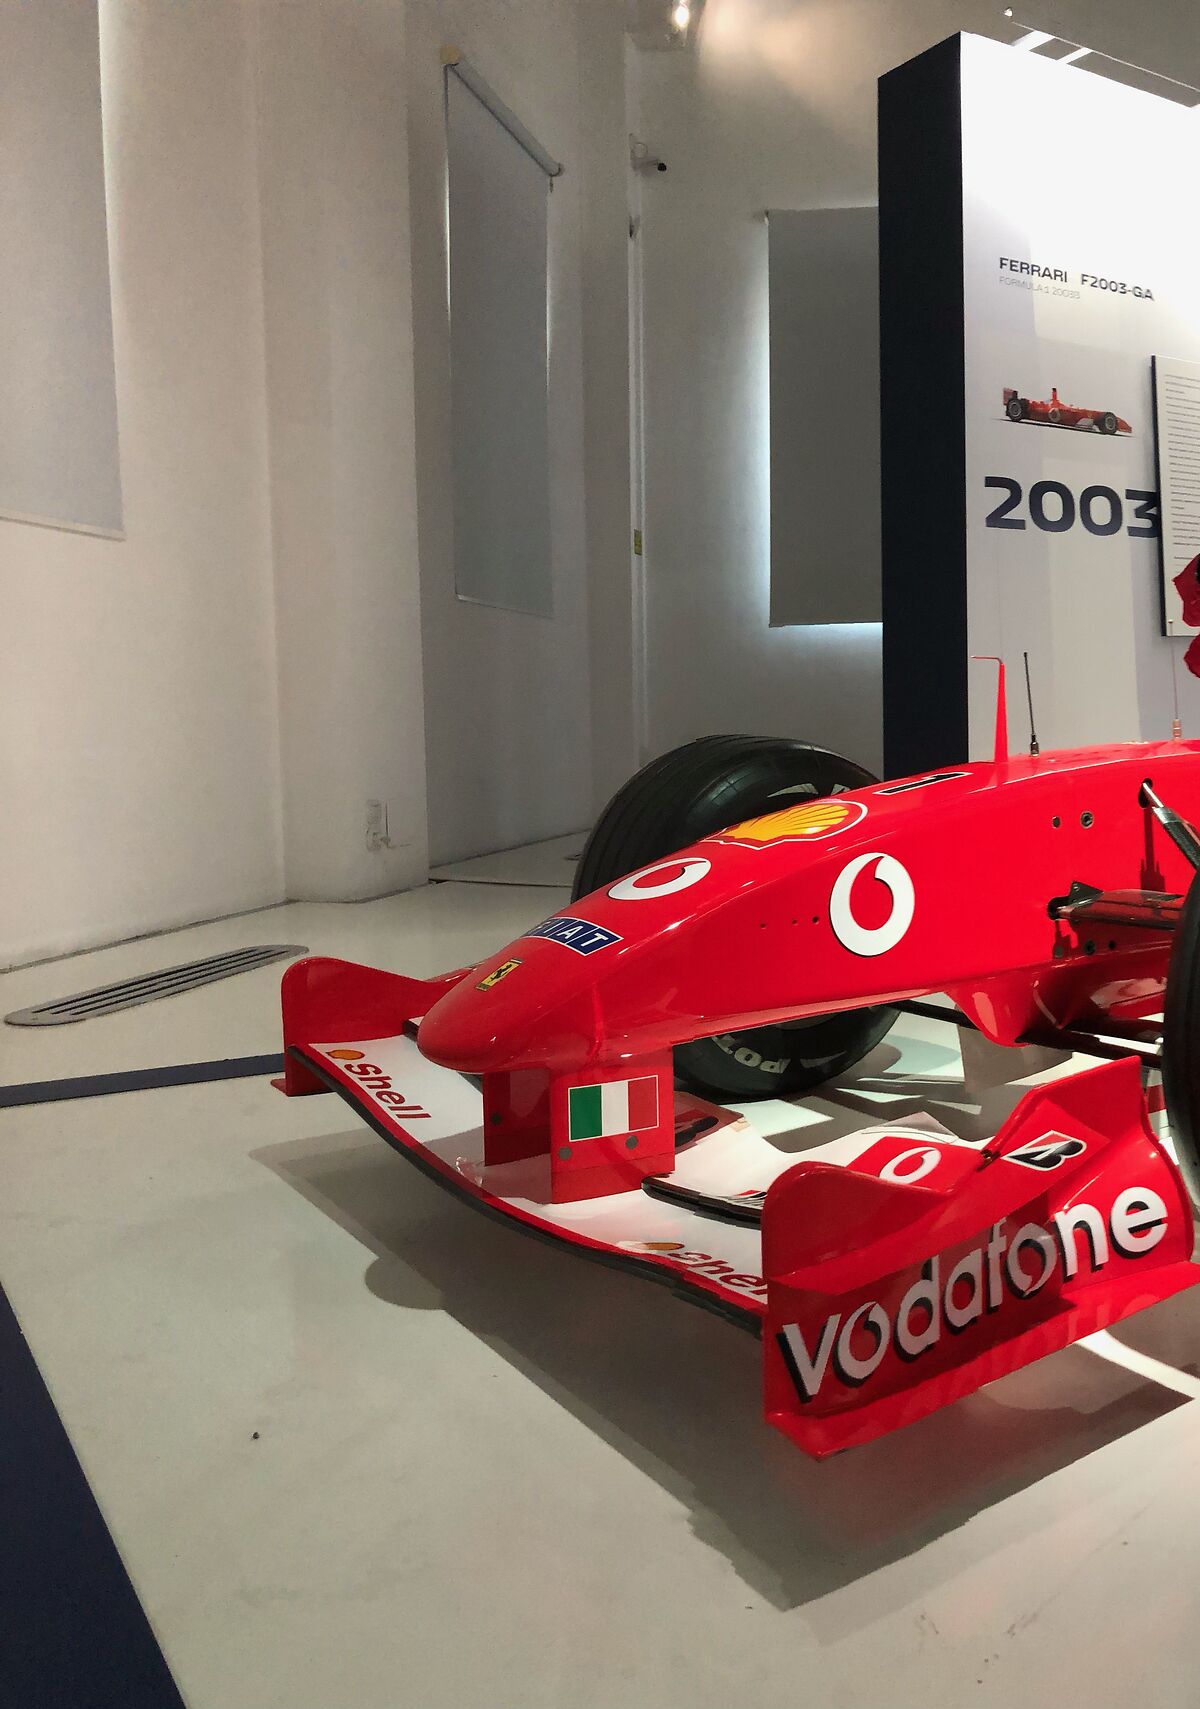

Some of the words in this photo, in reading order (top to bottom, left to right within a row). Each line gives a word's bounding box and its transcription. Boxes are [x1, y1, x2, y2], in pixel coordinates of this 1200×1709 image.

[999, 257, 1068, 283] FERRARI
[1081, 273, 1155, 301] F2003-GA
[984, 476, 1159, 538] 2003
[343, 1062, 432, 1120] Shell
[778, 1186, 1168, 1403] vodafone
